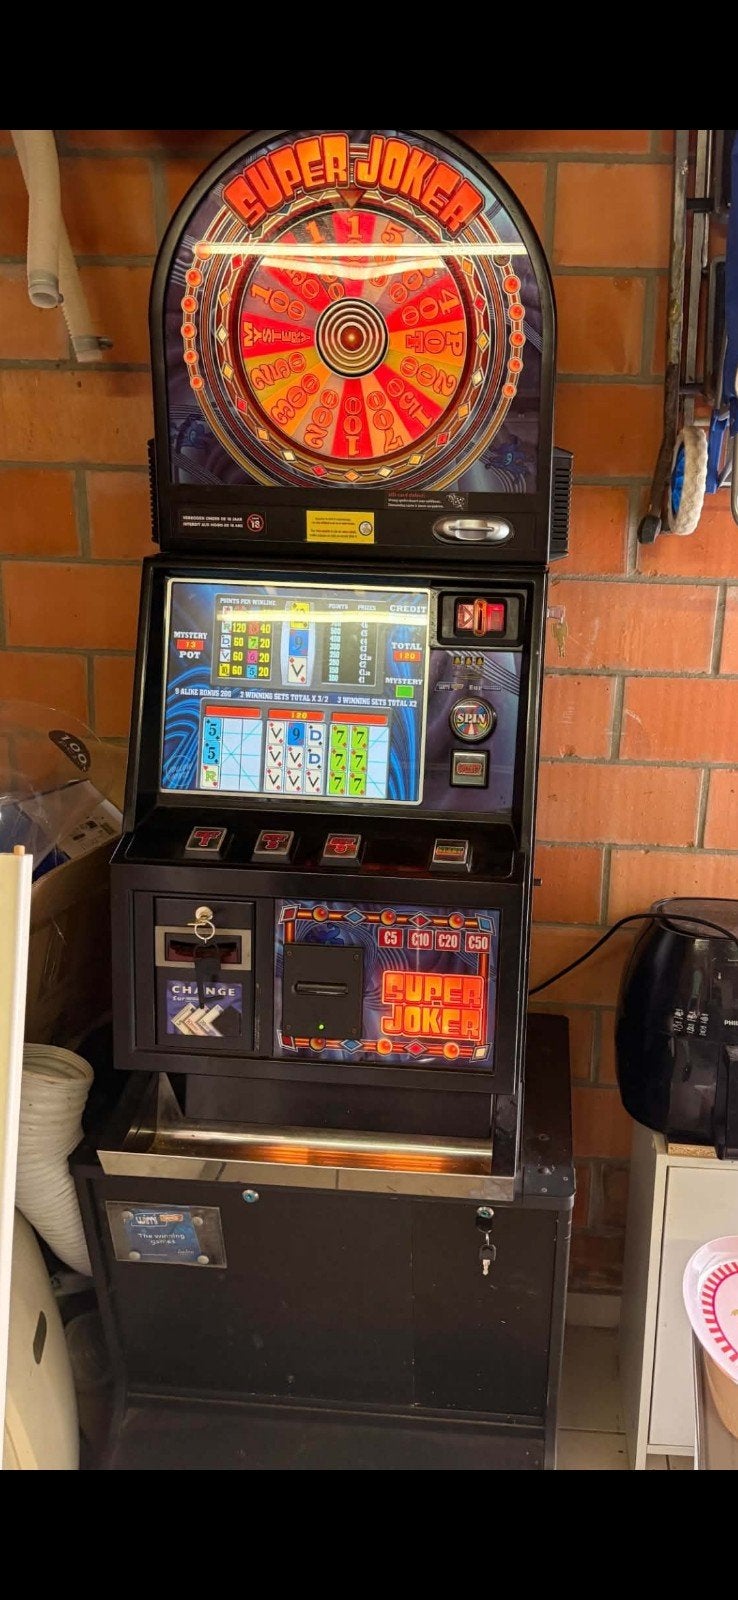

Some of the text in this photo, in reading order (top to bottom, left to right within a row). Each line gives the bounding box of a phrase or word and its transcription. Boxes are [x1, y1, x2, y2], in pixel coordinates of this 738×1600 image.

[223, 133, 485, 238] SUPER JOKER
[250, 283, 306, 321] 100
[401, 289, 461, 326] 400
[243, 321, 311, 347] MYSTERY
[406, 330, 464, 356] POT
[400, 356, 457, 396] 200
[271, 373, 320, 425] 300
[386, 378, 433, 428] 150
[304, 389, 339, 449] 200
[343, 396, 362, 456] 100
[366, 391, 404, 453] 700
[251, 520, 261, 529] 18
[389, 604, 427, 613] CREDIT
[173, 631, 208, 639] MYSTERY
[233, 623, 246, 633] 120
[260, 624, 271, 634] 40
[233, 637, 244, 647] 60
[260, 638, 271, 648] 20
[391, 642, 423, 651] TOTAL
[179, 651, 201, 659] POT
[233, 652, 243, 661] 60
[259, 653, 270, 663] 20
[399, 652, 416, 660] 120
[232, 666, 243, 676] 60
[258, 667, 269, 677] 20
[385, 677, 423, 685] MYSTERY
[180, 688, 199, 696] ALIKE
[245, 691, 273, 700] WINNING
[274, 692, 290, 700] SETS
[290, 693, 311, 702] TOTAL
[342, 697, 371, 705] WINNING
[371, 698, 387, 706] SETS
[388, 699, 408, 707] TOTAL
[457, 713, 486, 724] SPIN
[208, 723, 217, 736] 5
[271, 727, 322, 741] V 9 D
[336, 730, 365, 744] 7 7
[207, 747, 216, 760] 5
[269, 751, 321, 764] V V D
[335, 753, 363, 768] 7 7
[205, 770, 216, 782] R
[269, 774, 319, 787] V V V
[334, 777, 362, 791] 7 7
[384, 931, 489, 950] €5 €10 €20 €50
[384, 972, 483, 1005] SUPER
[382, 1004, 482, 1039] JOKER
